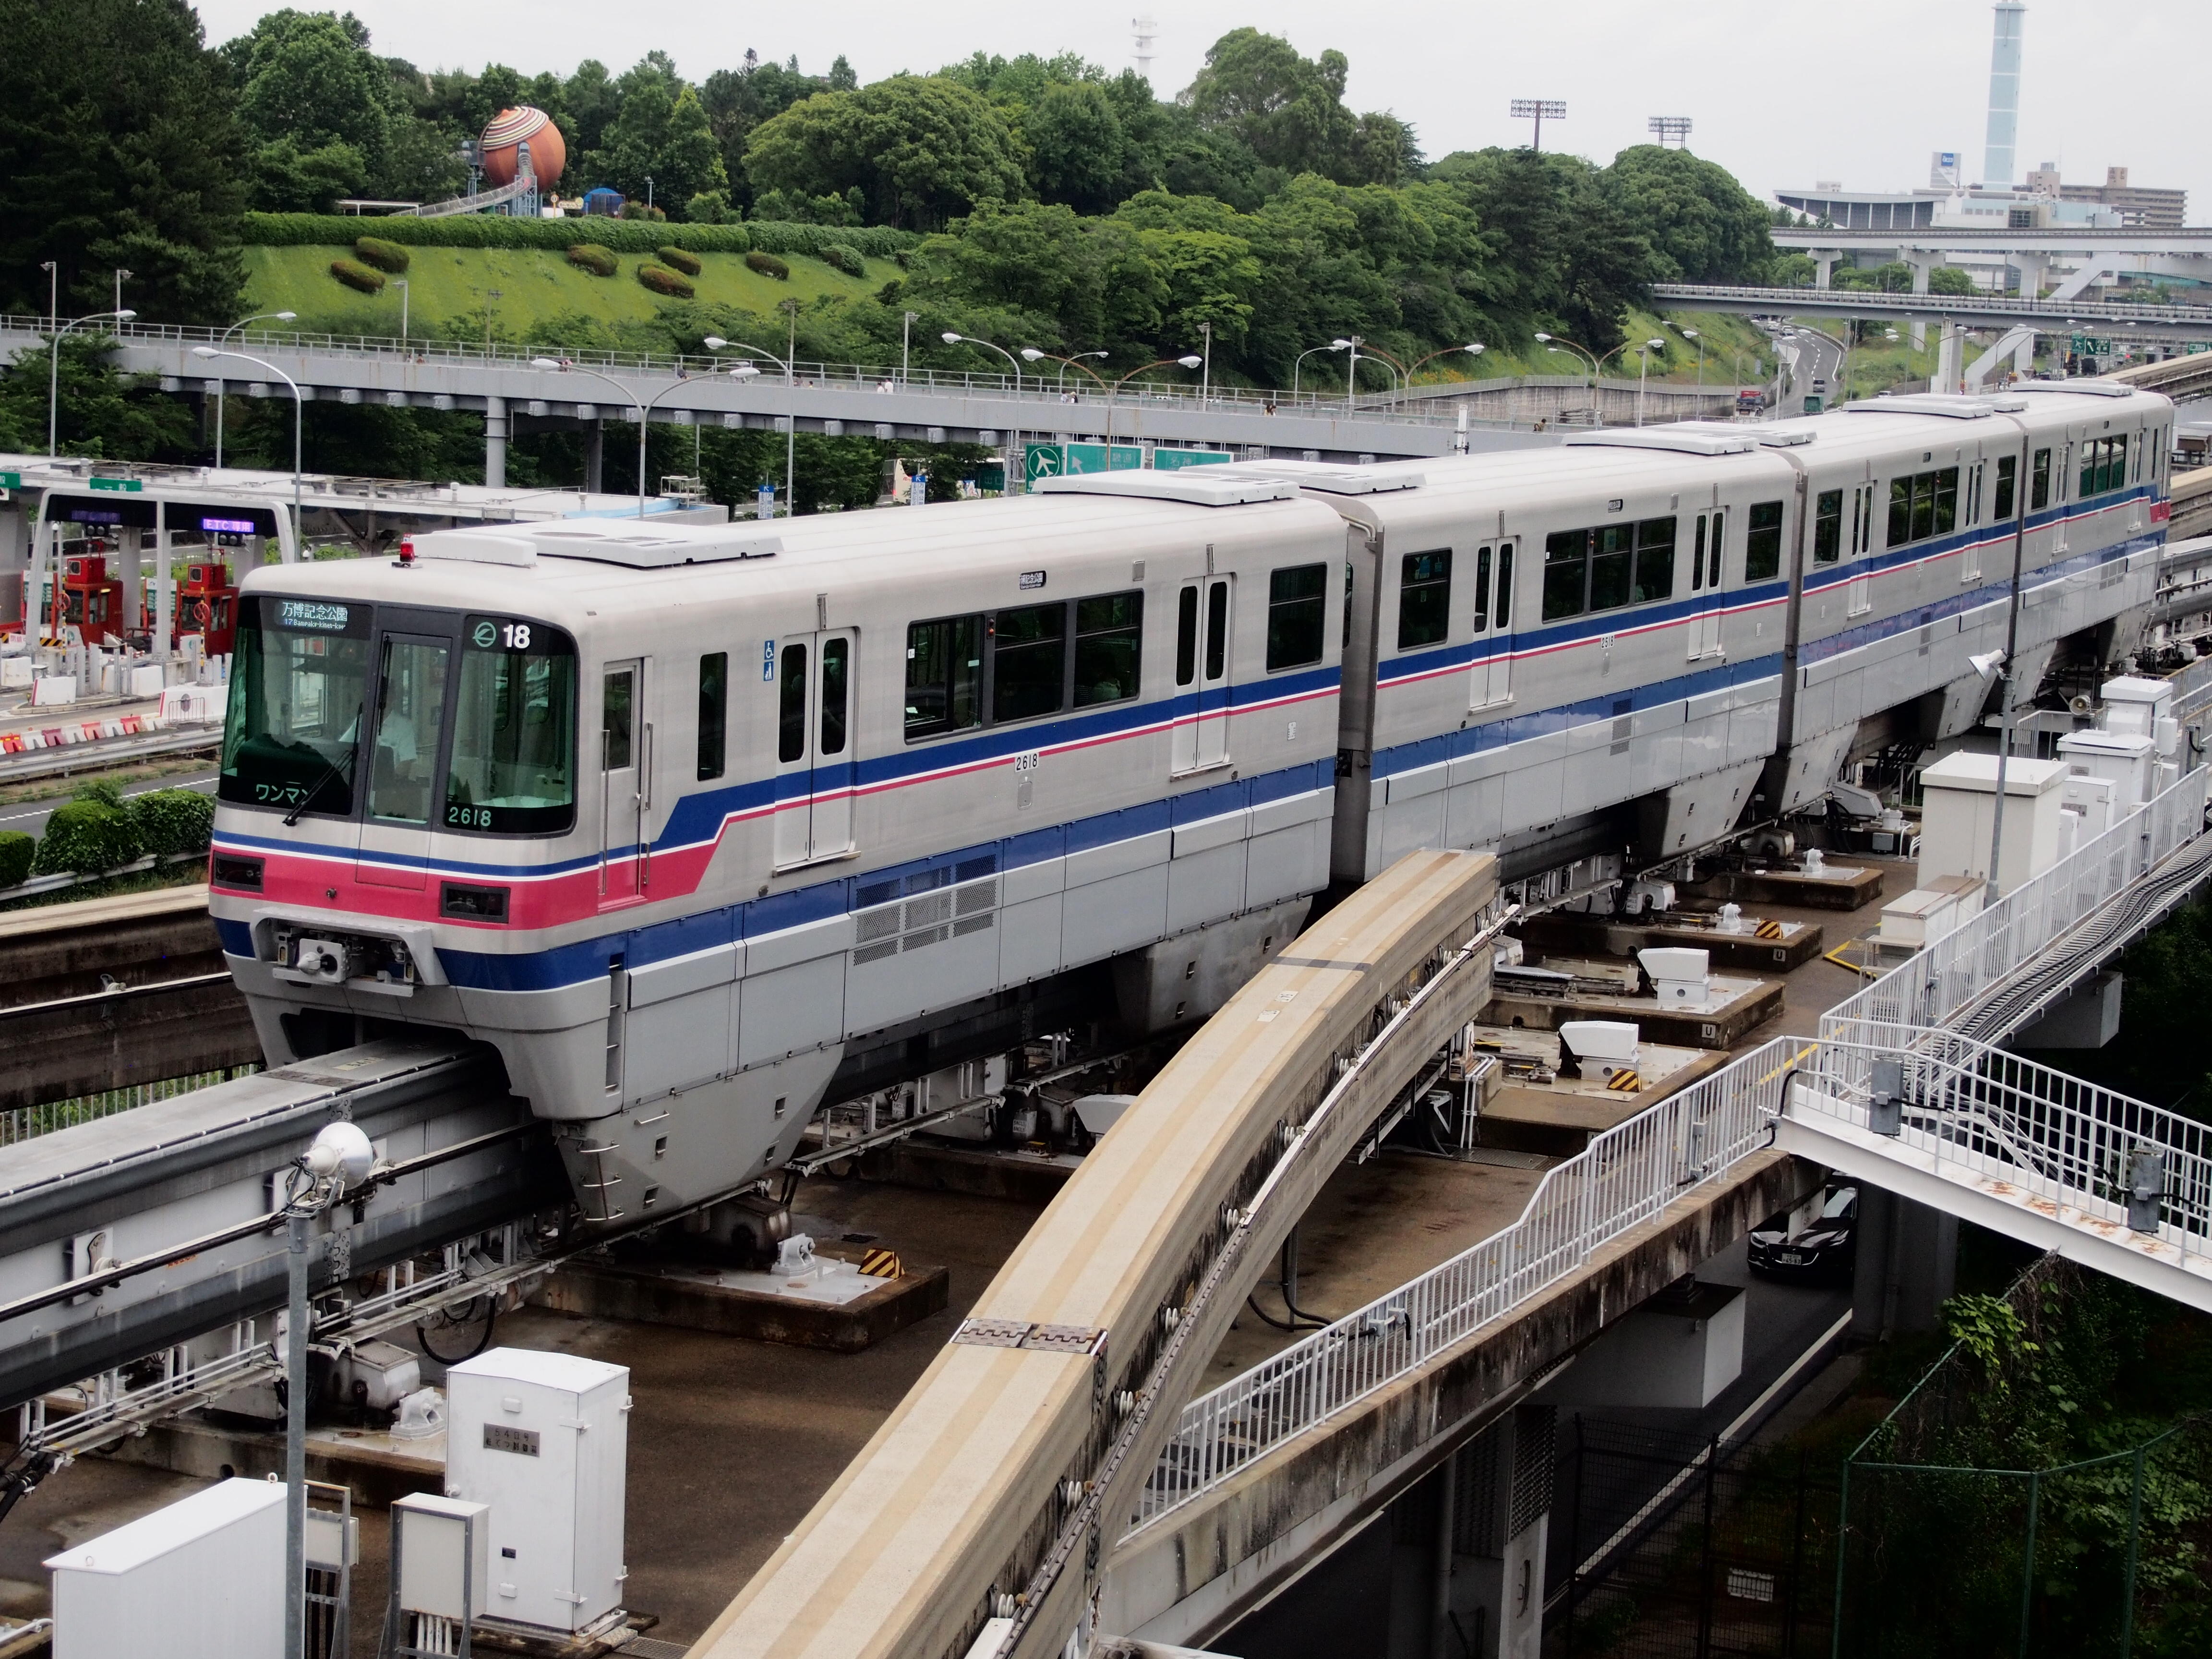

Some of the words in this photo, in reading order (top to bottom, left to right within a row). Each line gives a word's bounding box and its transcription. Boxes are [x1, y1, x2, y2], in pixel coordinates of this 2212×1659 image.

[206, 519, 228, 530] ETC
[282, 602, 348, 622] 万博記念公園
[503, 624, 530, 649] 18
[1601, 636, 1613, 648] 2518
[1016, 754, 1037, 770] 2618
[448, 806, 492, 827] 2618
[1706, 1026, 1712, 1036] U
